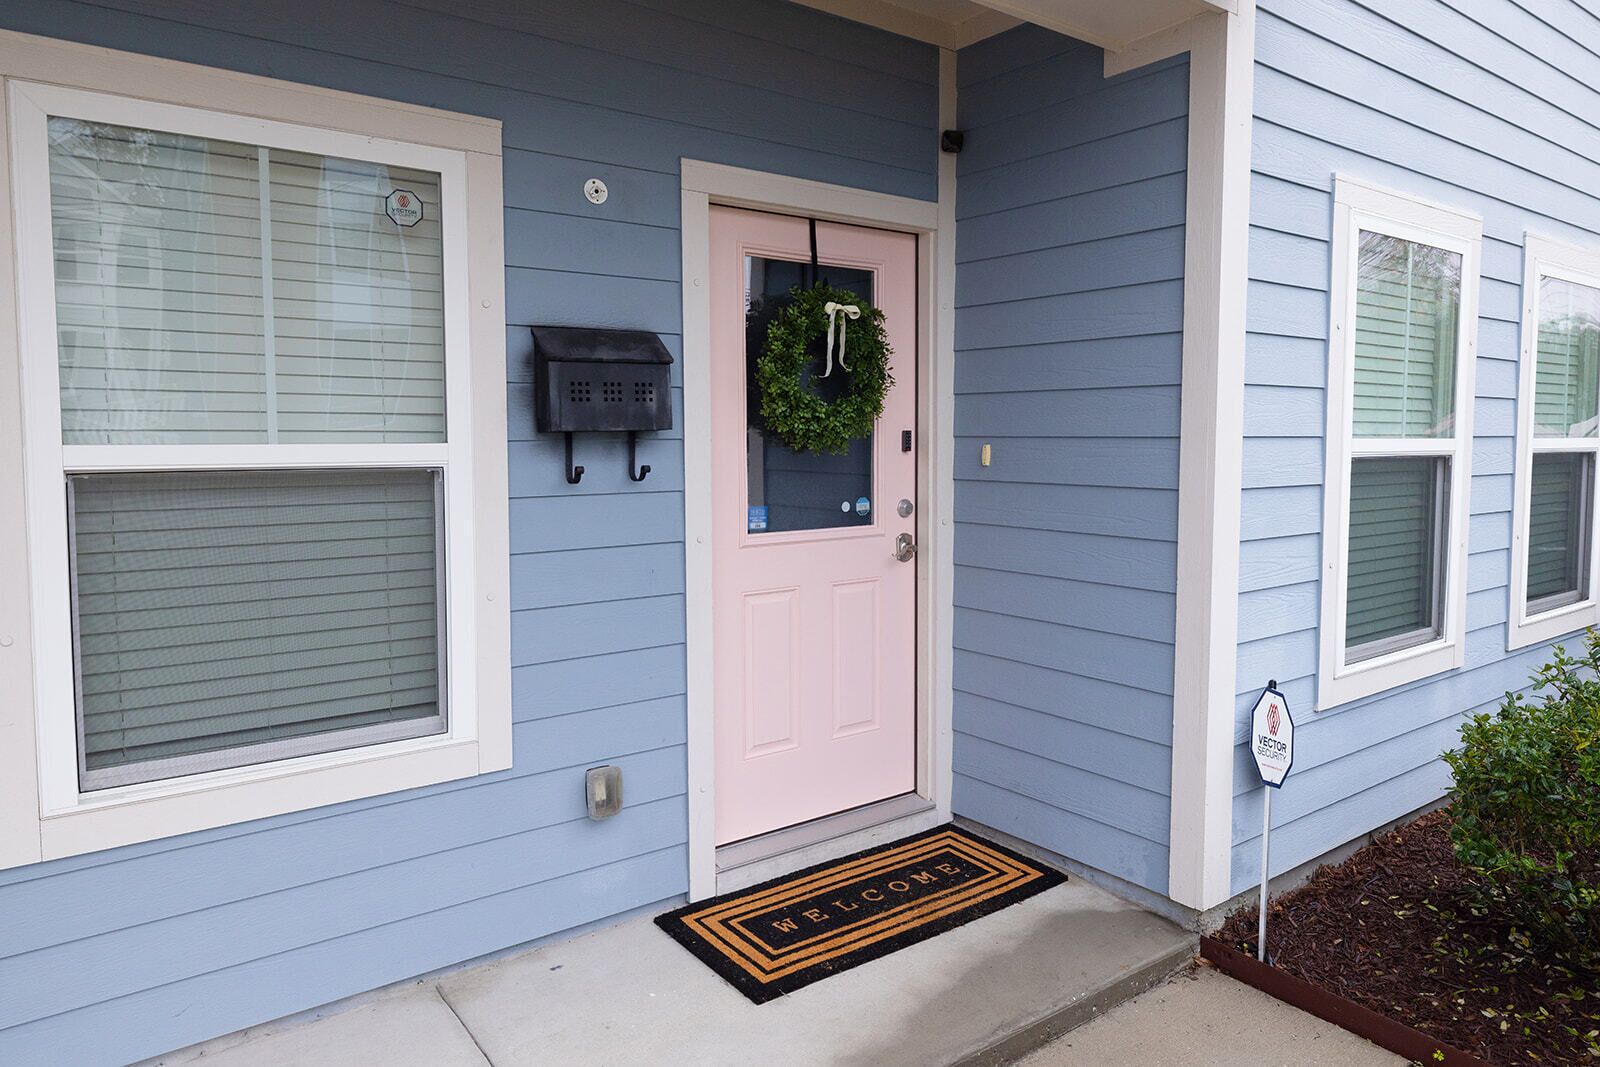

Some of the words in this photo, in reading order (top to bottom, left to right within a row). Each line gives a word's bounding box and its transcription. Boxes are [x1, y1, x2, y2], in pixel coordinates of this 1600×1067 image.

[1258, 734, 1287, 753] VECTOR
[1257, 745, 1287, 762] SECURITY
[772, 862, 961, 934] WELCOME
